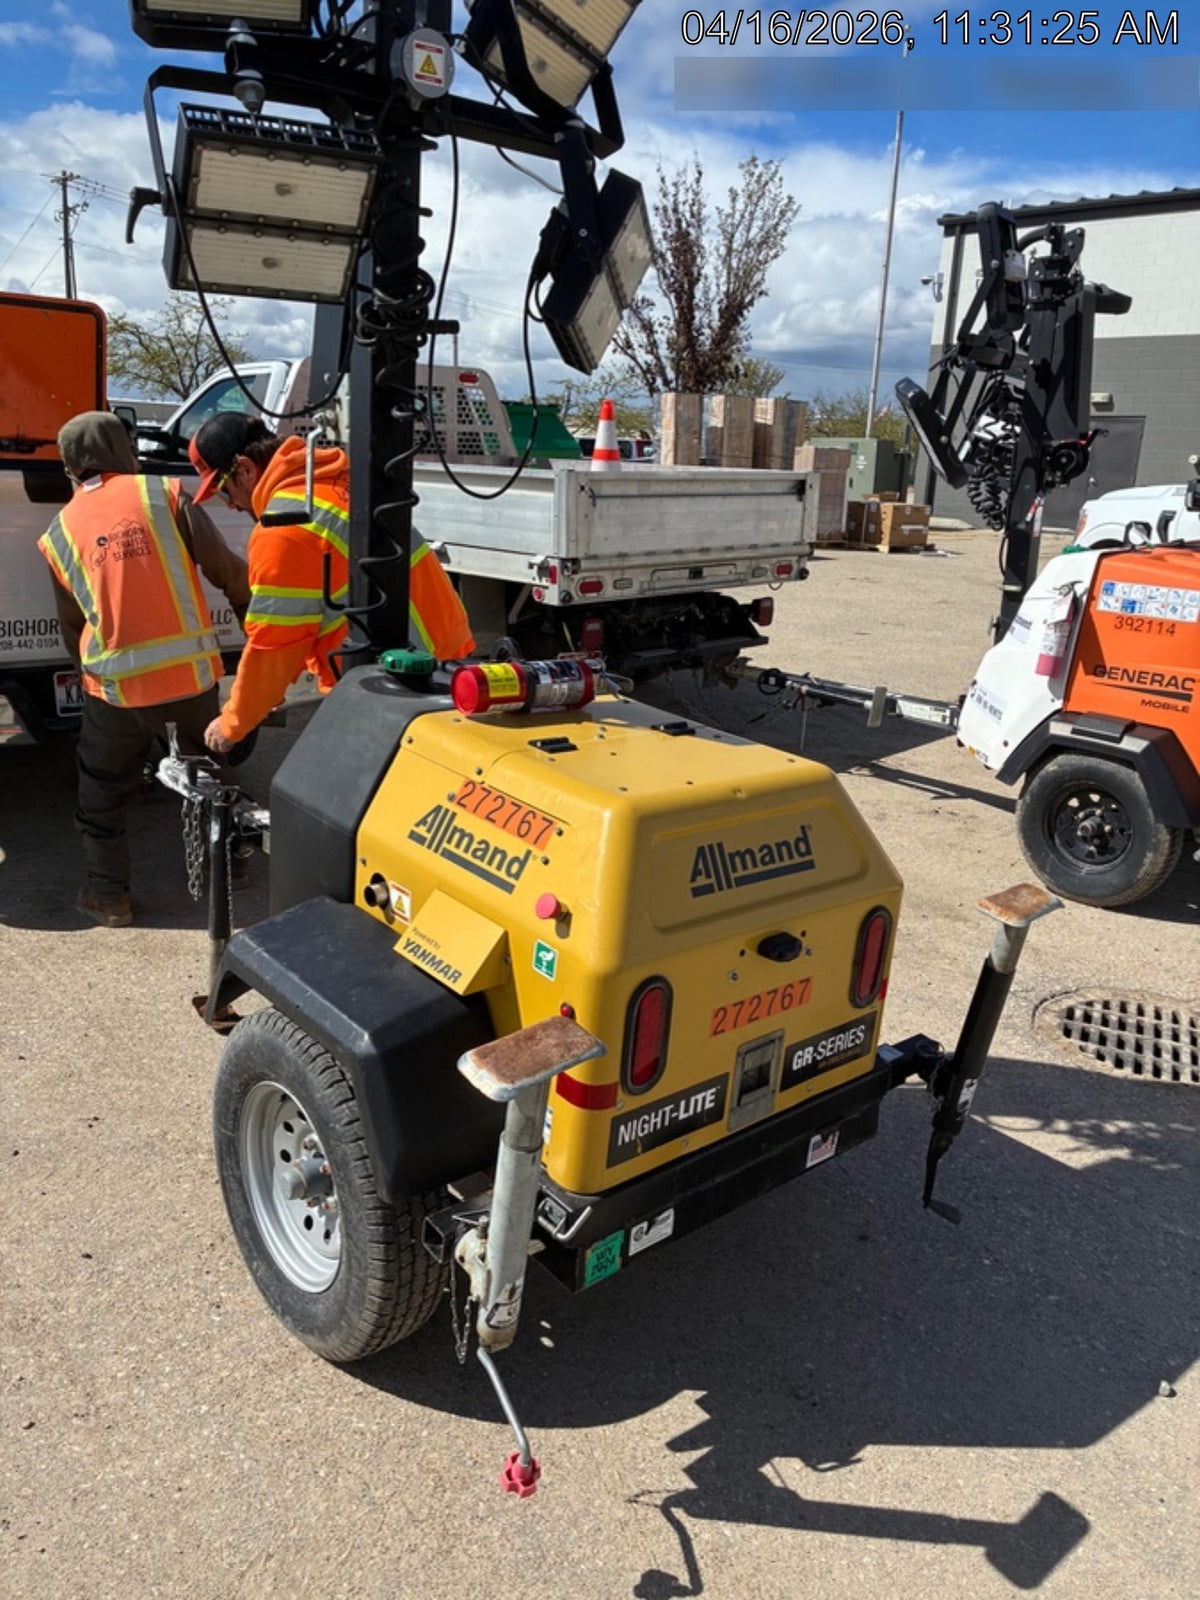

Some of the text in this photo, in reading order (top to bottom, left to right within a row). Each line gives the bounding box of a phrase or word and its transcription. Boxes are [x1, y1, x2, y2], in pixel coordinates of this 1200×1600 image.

[0, 608, 232, 638] BIGHOR LLC
[1114, 615, 1177, 636] 392114
[1093, 664, 1197, 692] GENERAC
[1140, 699, 1191, 714] MOBILE
[456, 780, 554, 846] 272767
[414, 804, 533, 881] Allmand
[689, 824, 813, 892] Allmand
[402, 937, 463, 984] YANMAR
[712, 977, 812, 1036] 272767
[792, 1024, 866, 1071] GR-SERIES
[617, 1088, 718, 1146] NIGHT-LITE
